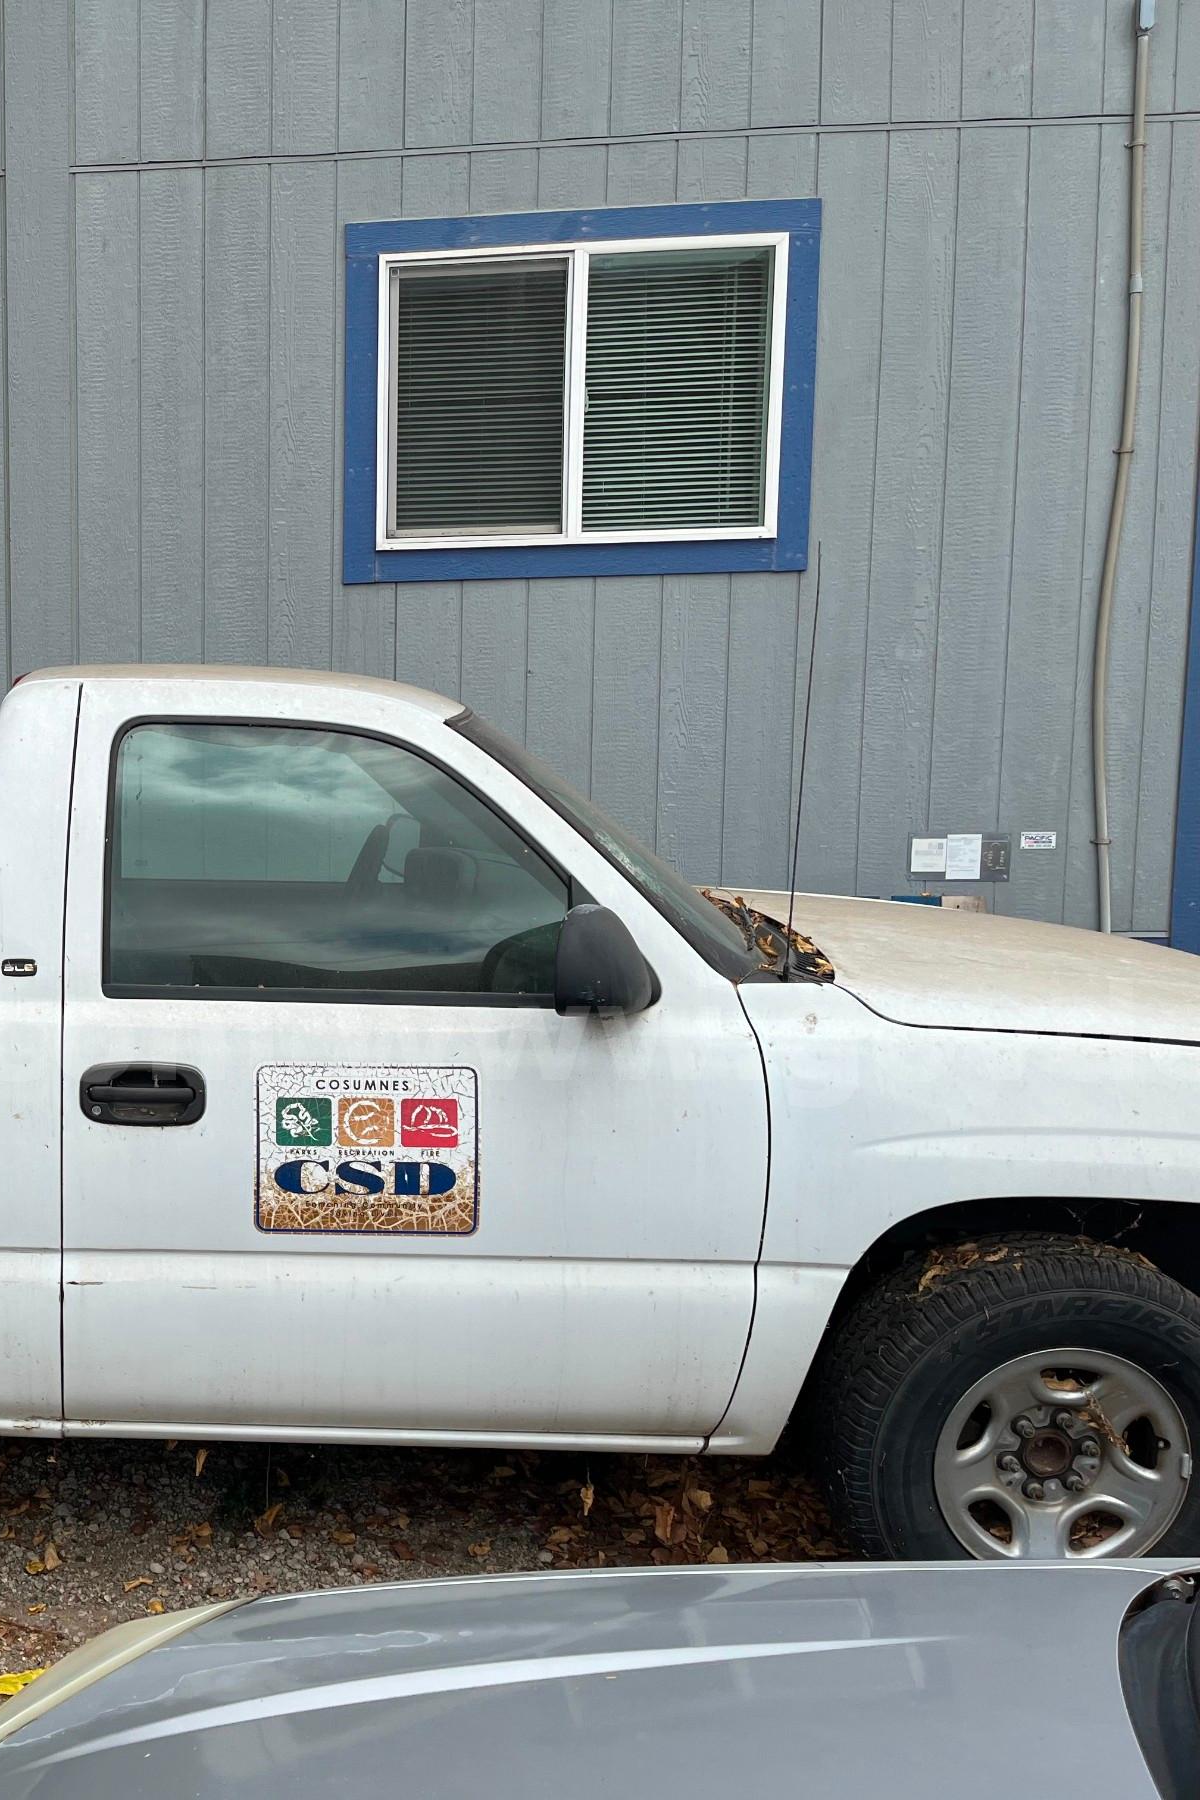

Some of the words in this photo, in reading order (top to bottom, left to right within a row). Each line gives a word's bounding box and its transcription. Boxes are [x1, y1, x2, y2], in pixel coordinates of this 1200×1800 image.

[315, 1079, 410, 1092] COSUMNES
[274, 1159, 457, 1196] CSD
[975, 1296, 1200, 1345] STARFIRE
